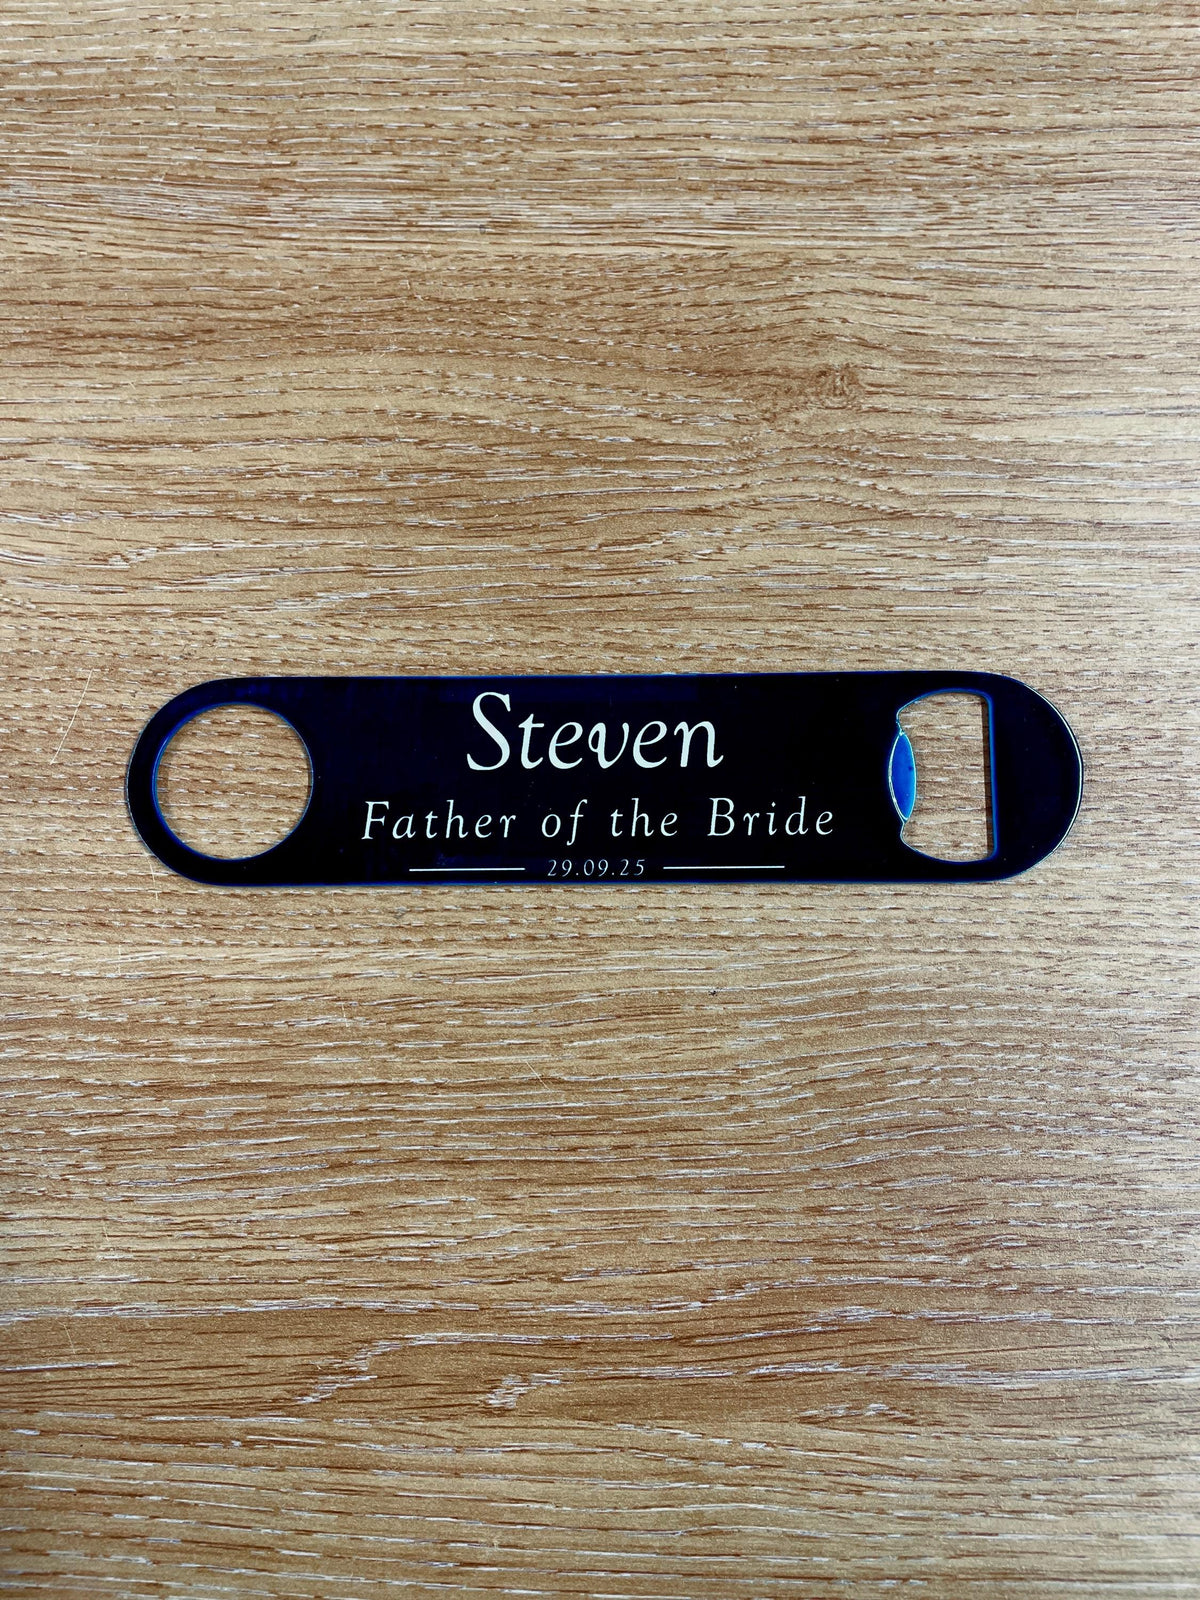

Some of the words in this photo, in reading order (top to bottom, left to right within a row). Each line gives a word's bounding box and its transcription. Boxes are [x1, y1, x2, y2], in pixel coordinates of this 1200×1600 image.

[466, 691, 724, 771] Steven
[361, 799, 517, 840] Father
[541, 798, 588, 846] of
[610, 797, 678, 838] the
[707, 795, 835, 837] Bride
[547, 859, 645, 877] 29.09.25
